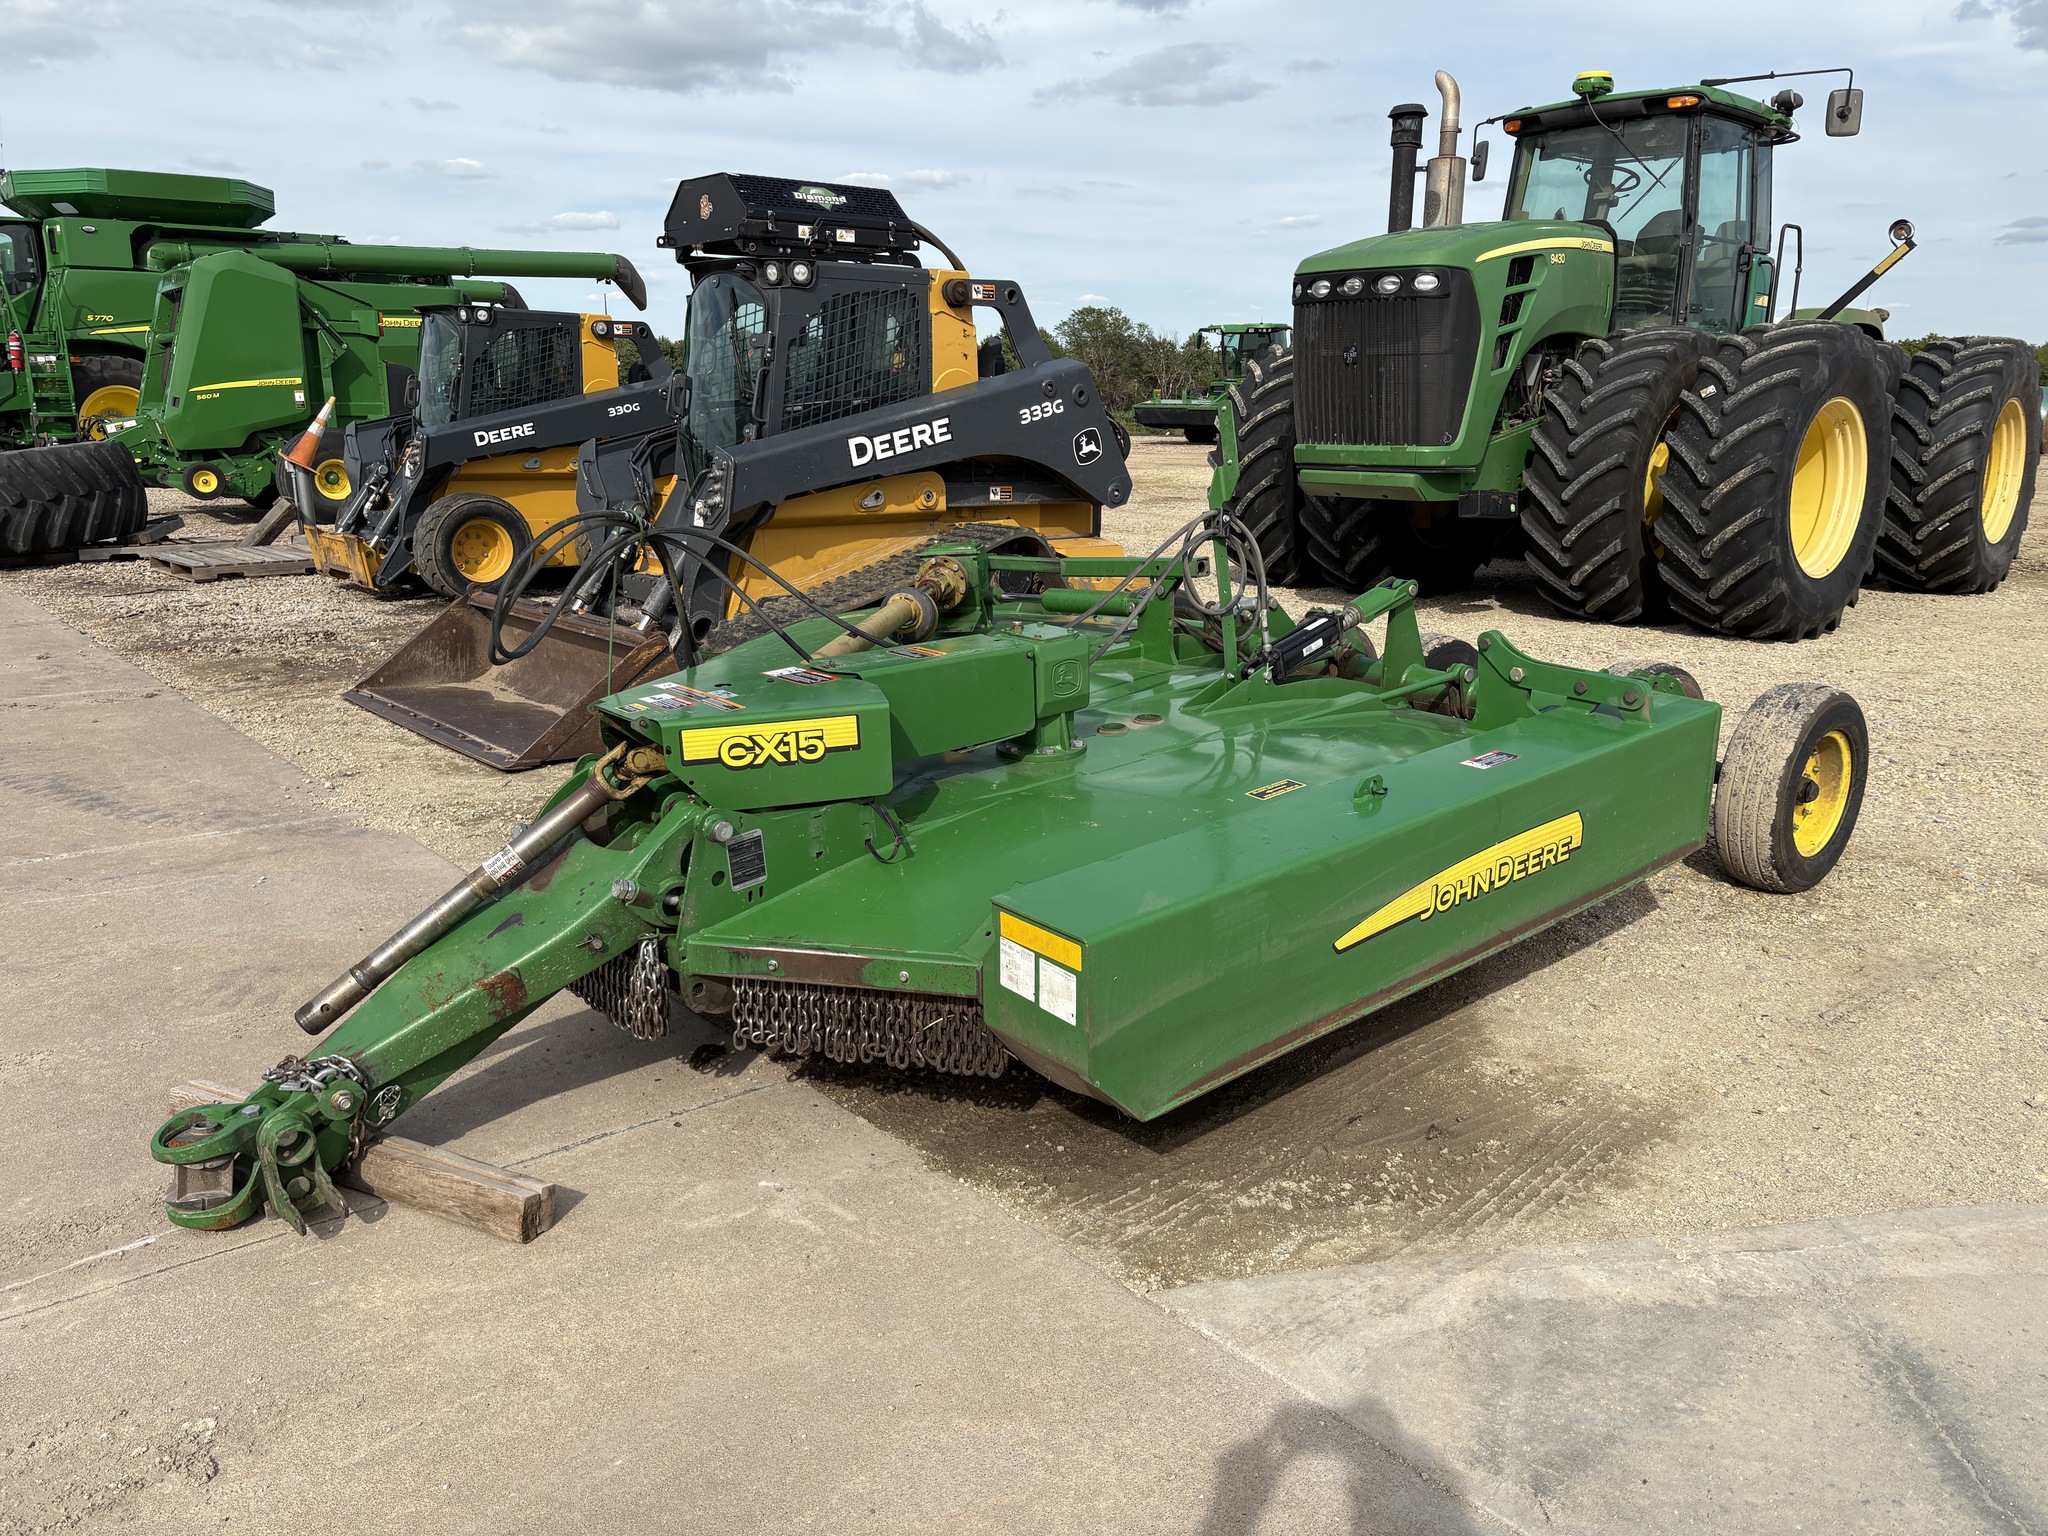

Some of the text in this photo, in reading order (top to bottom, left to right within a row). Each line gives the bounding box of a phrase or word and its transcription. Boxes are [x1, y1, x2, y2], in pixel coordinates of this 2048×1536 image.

[792, 191, 847, 204] Diamond
[1580, 240, 1604, 251] JOHN DEERE
[1550, 253, 1566, 264] 9430
[379, 319, 422, 327] JOHN DEE
[607, 402, 641, 417] 330G
[1019, 399, 1064, 424] 333G
[473, 422, 536, 447] DEERE
[847, 417, 952, 467] DEERE
[720, 730, 826, 768] CX15
[1420, 837, 1573, 921] JOHN DEERE
